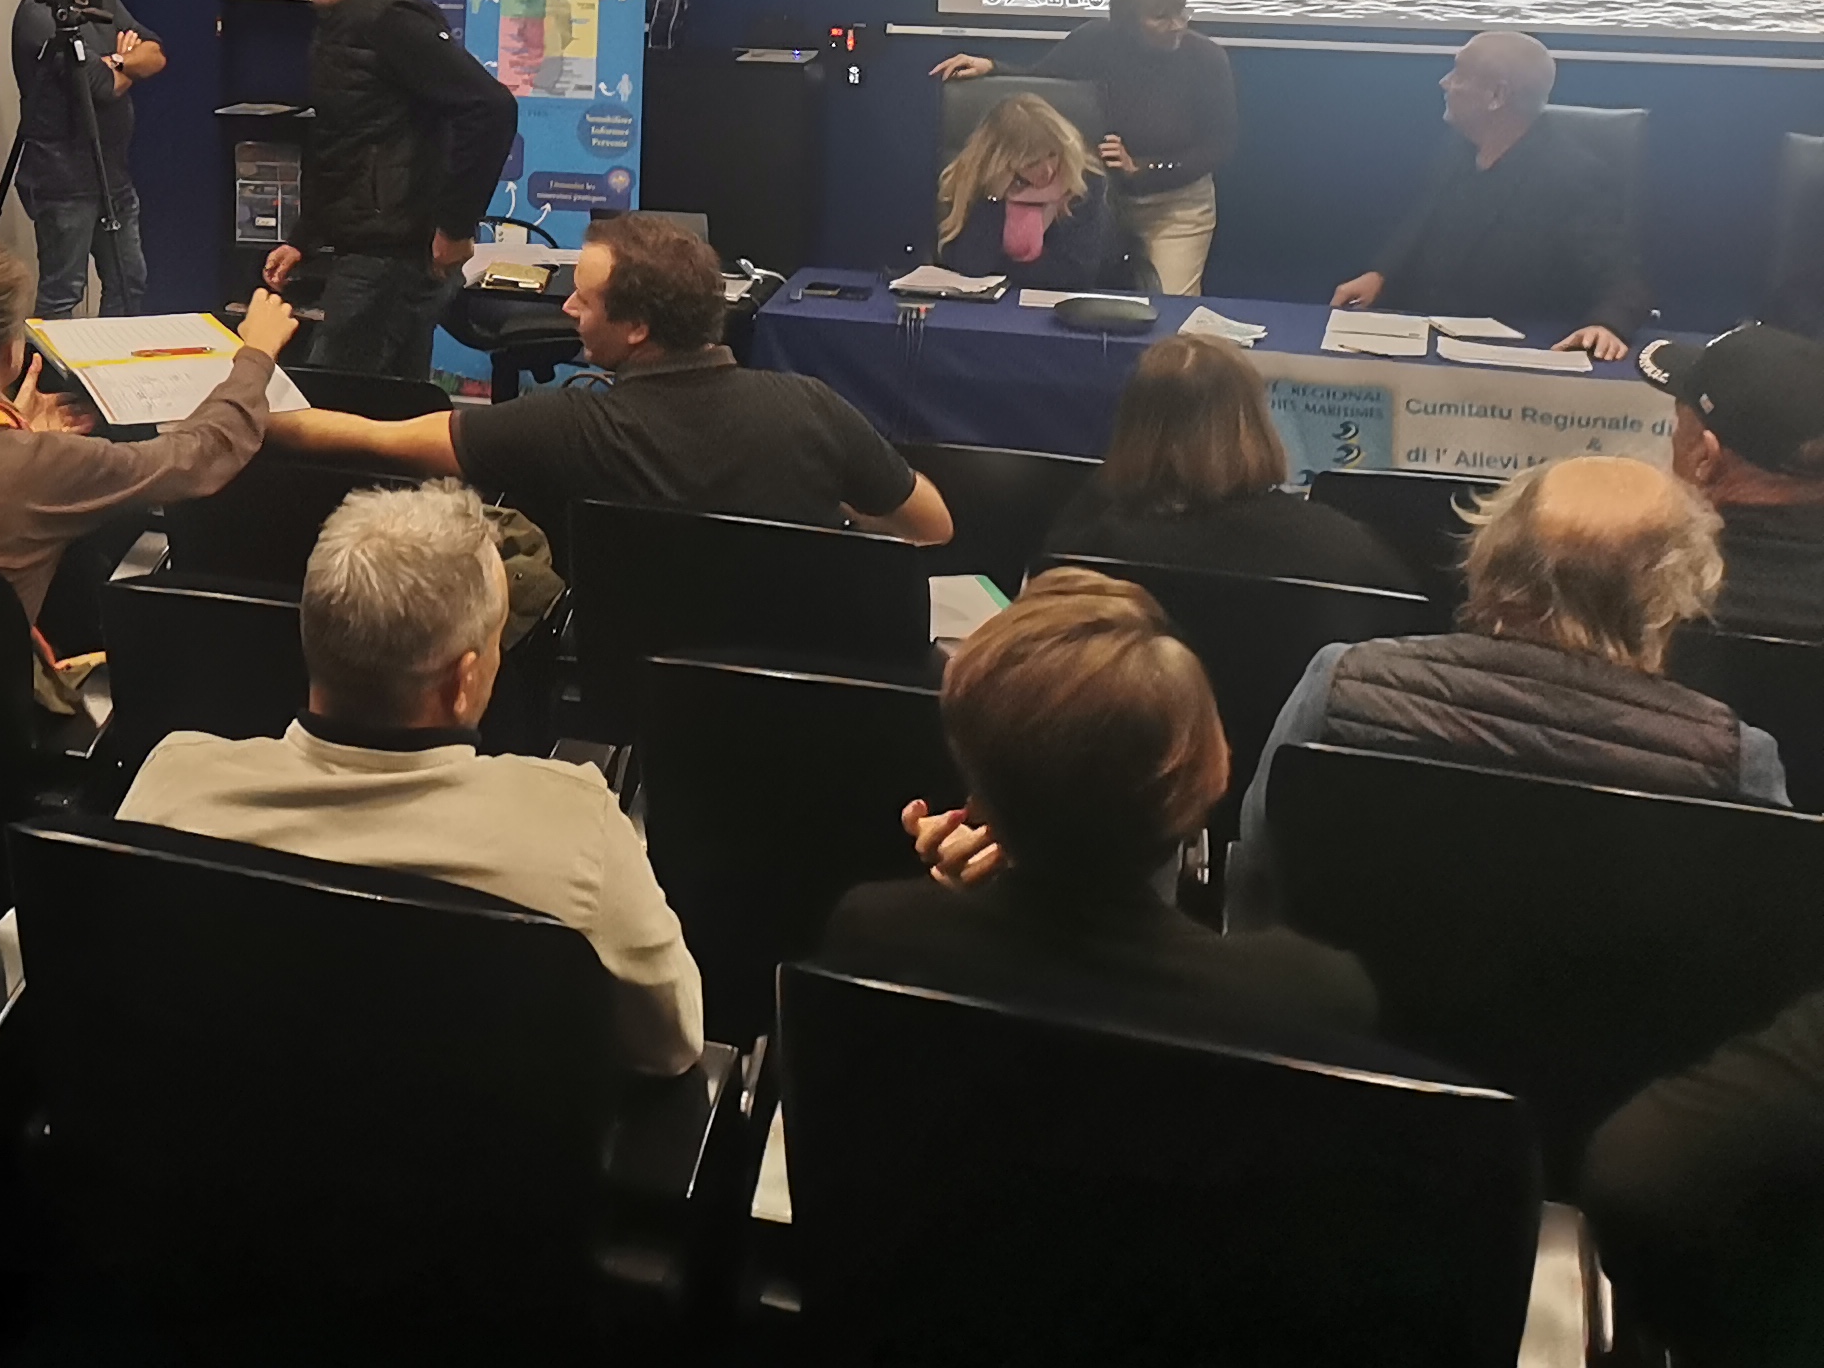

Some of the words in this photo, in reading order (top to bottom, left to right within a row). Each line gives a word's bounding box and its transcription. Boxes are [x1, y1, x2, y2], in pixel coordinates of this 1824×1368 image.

[1405, 398, 1513, 421] Cumitatu
[1521, 406, 1644, 433] Regiunale
[1406, 446, 1427, 464] di
